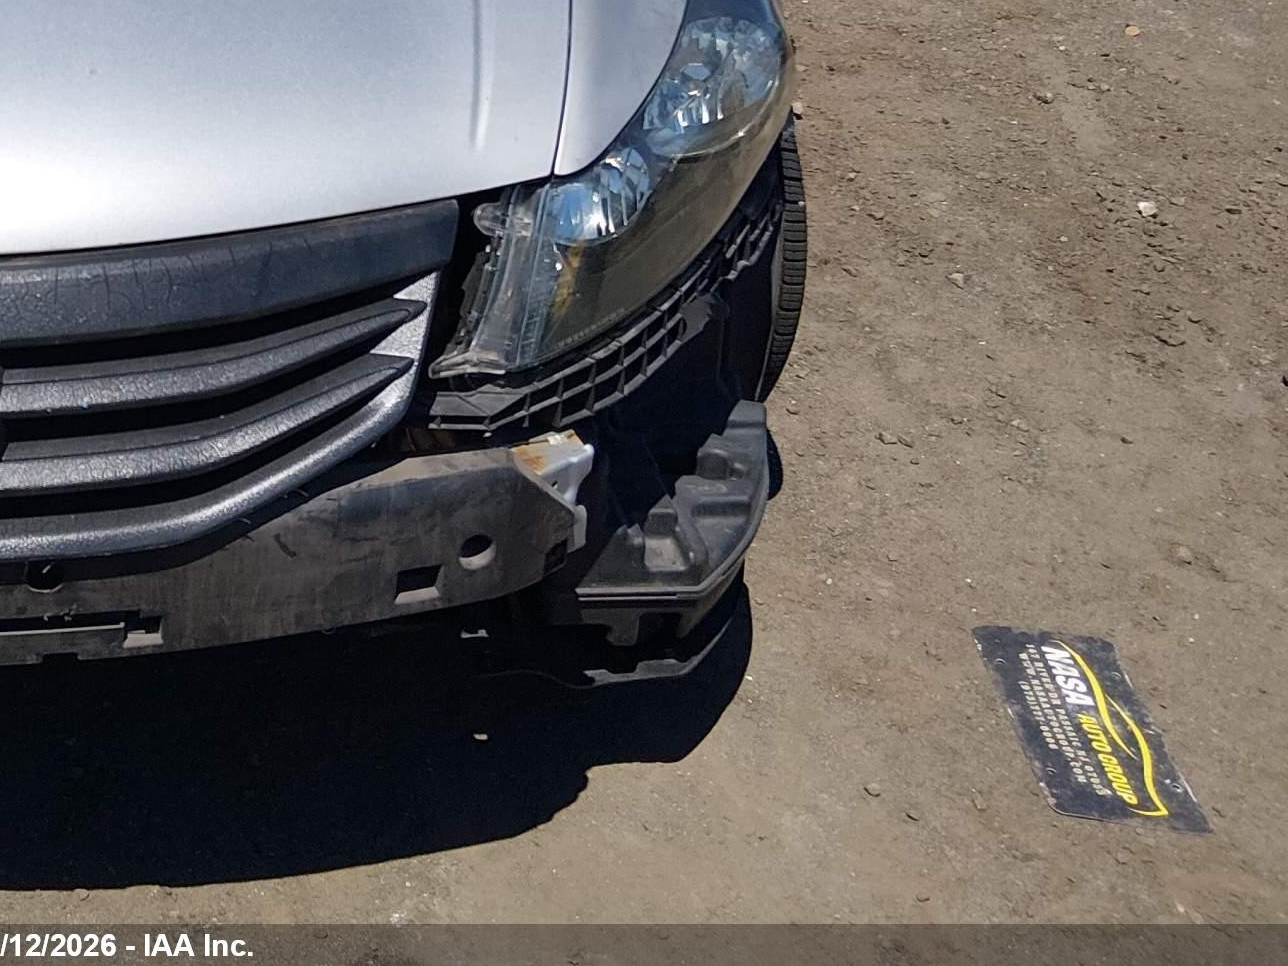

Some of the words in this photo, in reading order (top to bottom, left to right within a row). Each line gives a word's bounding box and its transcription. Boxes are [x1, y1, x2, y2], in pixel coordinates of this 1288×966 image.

[1040, 646, 1095, 706] NASA
[1075, 713, 1112, 752] AUTO
[1097, 753, 1139, 805] GROUP
[1055, 708, 1082, 747] PASSAIC
